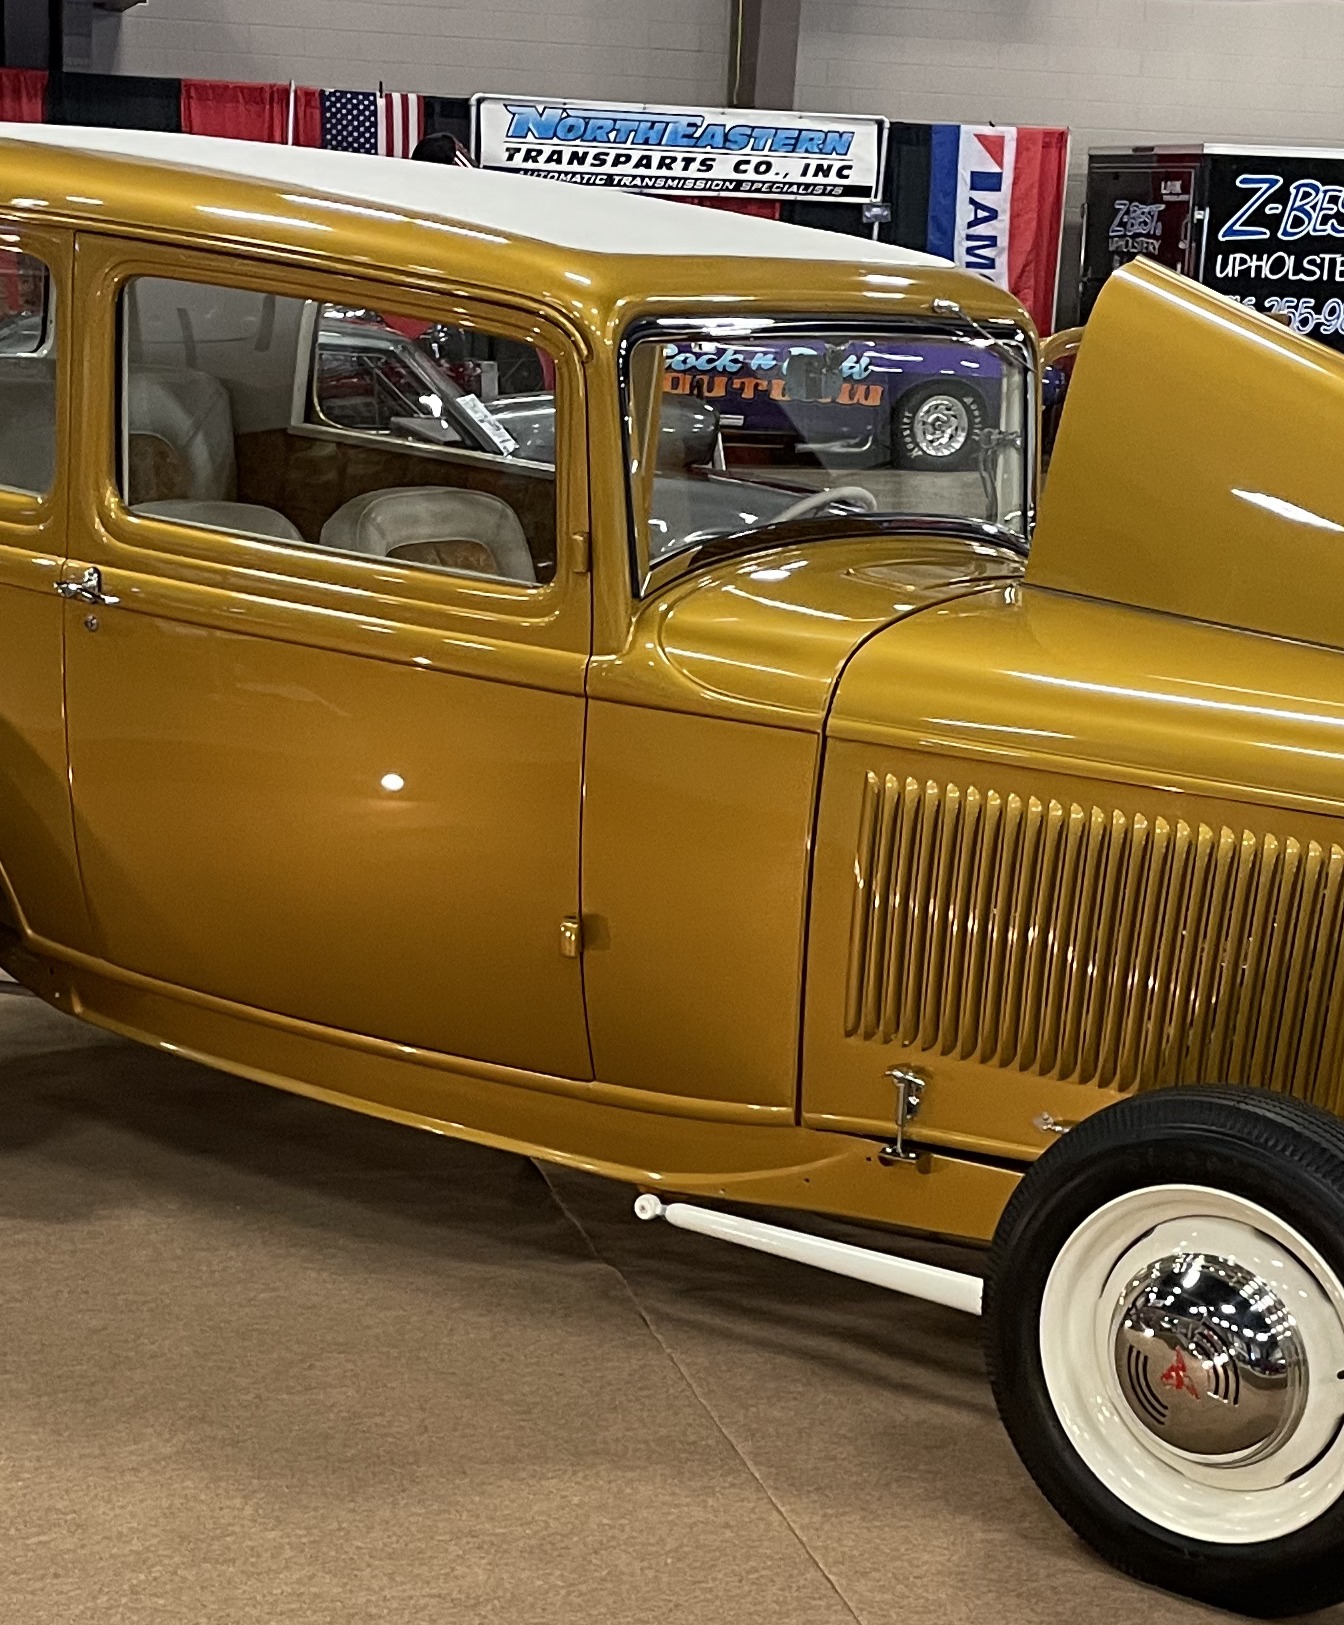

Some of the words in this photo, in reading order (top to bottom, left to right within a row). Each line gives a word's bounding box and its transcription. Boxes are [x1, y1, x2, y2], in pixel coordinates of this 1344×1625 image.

[503, 147, 716, 173] TRANSPARTS
[799, 163, 854, 179] INC
[612, 175, 737, 191] TRANSMISSION
[739, 181, 843, 196] SPECIALISTS
[663, 372, 885, 407] OUTLW
